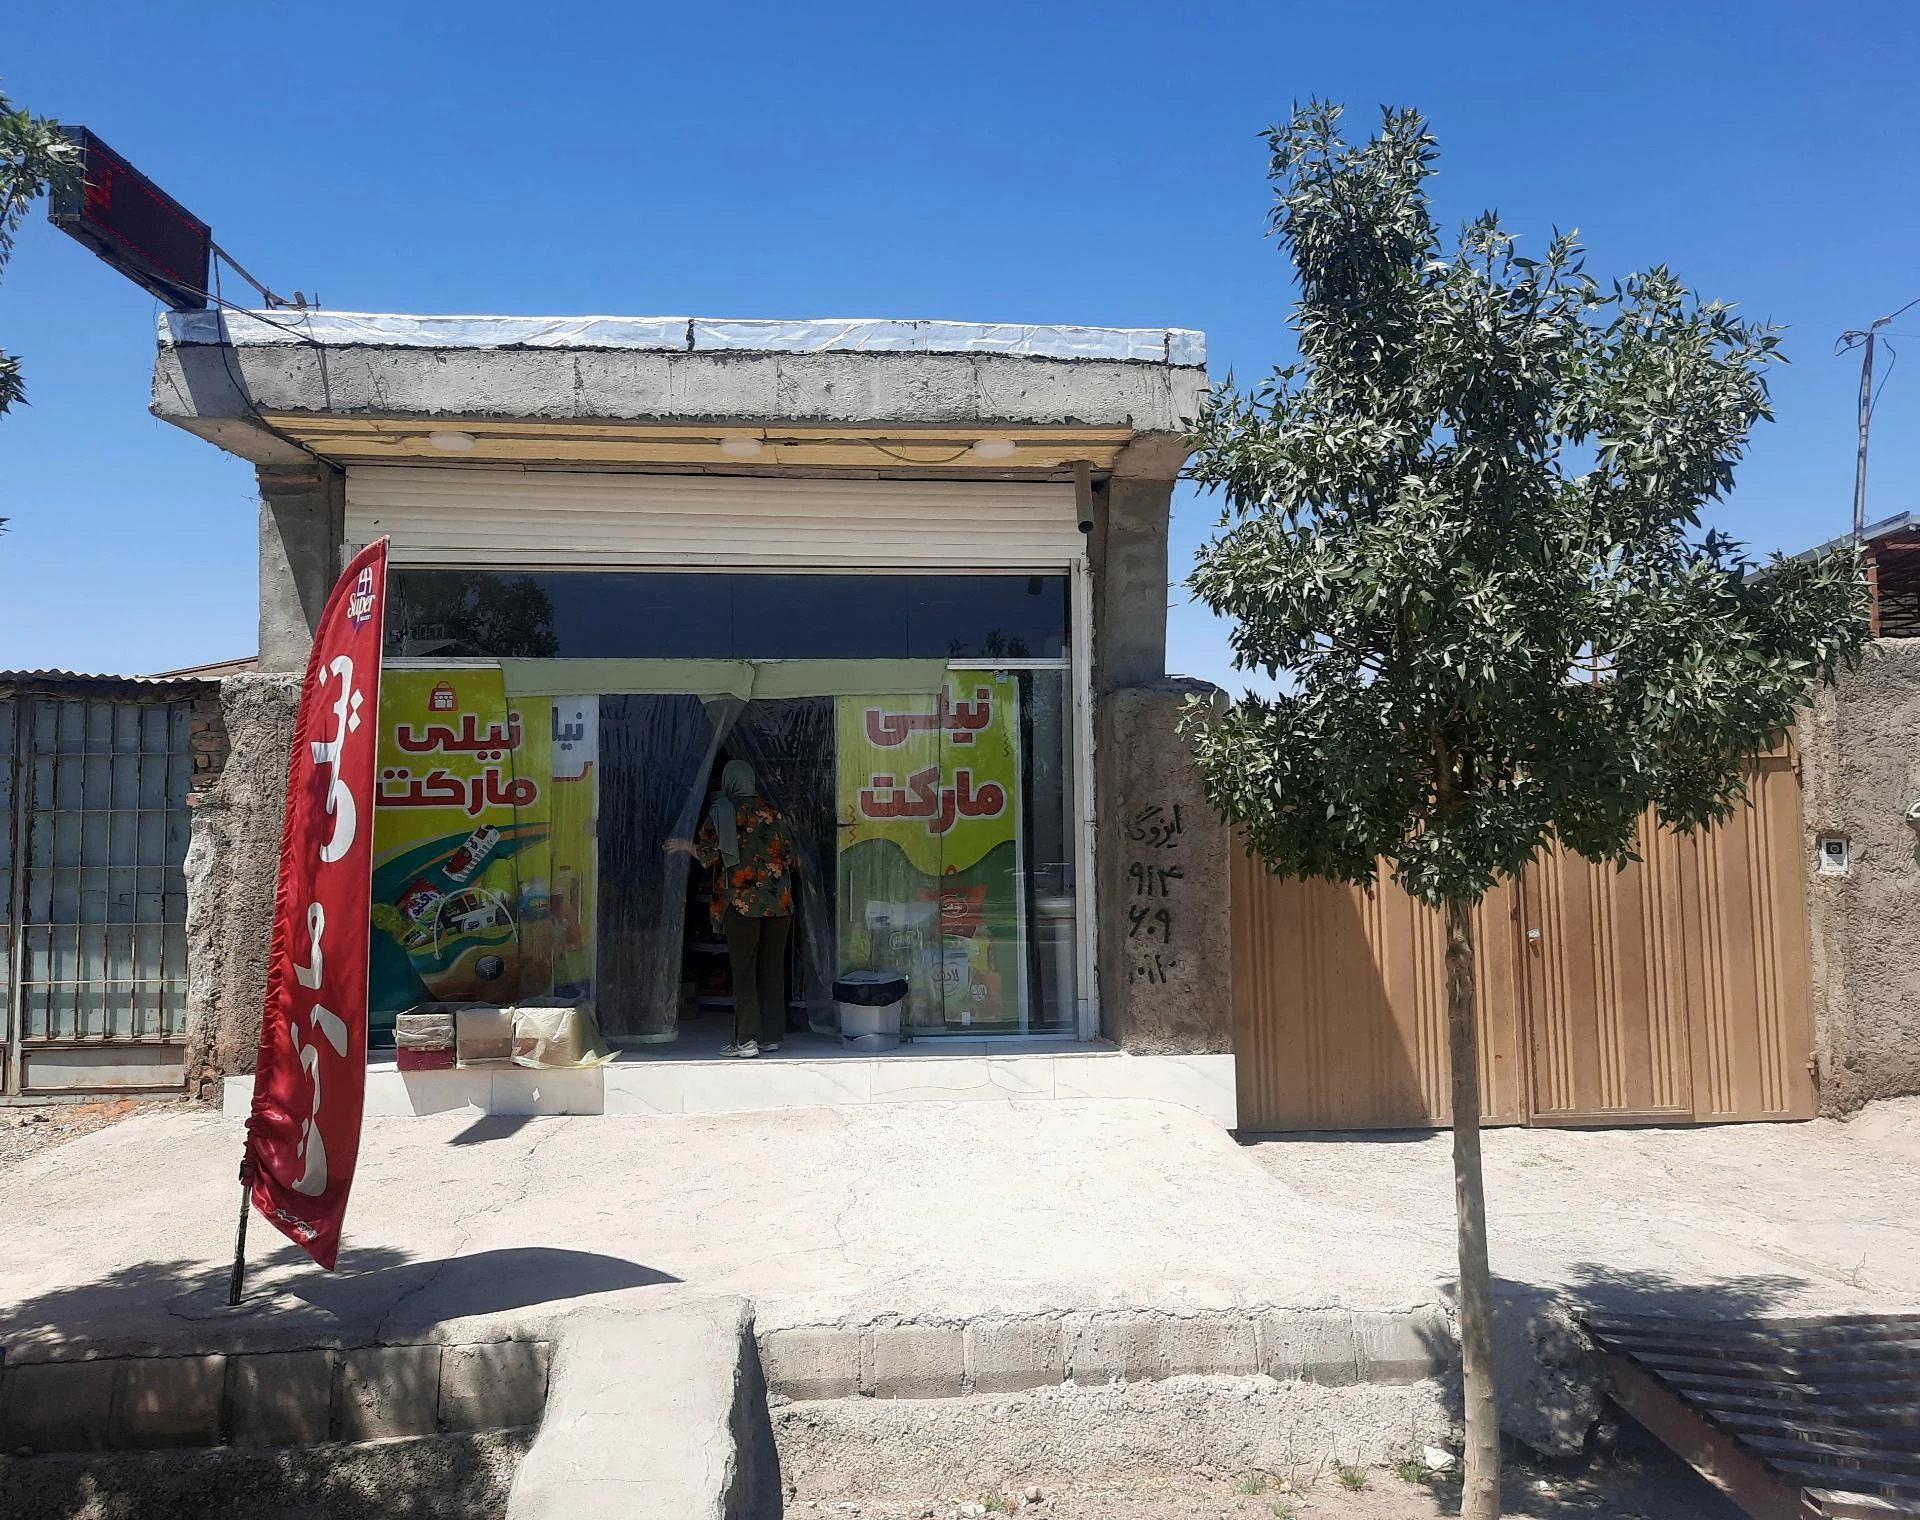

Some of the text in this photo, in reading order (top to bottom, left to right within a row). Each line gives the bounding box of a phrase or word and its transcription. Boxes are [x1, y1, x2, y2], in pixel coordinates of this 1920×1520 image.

[347, 592, 376, 623] Super
[397, 711, 523, 761] نیلی
[865, 684, 991, 747] نیلی
[376, 768, 538, 816] مارکت
[859, 766, 1005, 834] مارکت
[291, 902, 348, 1197] مارکت
